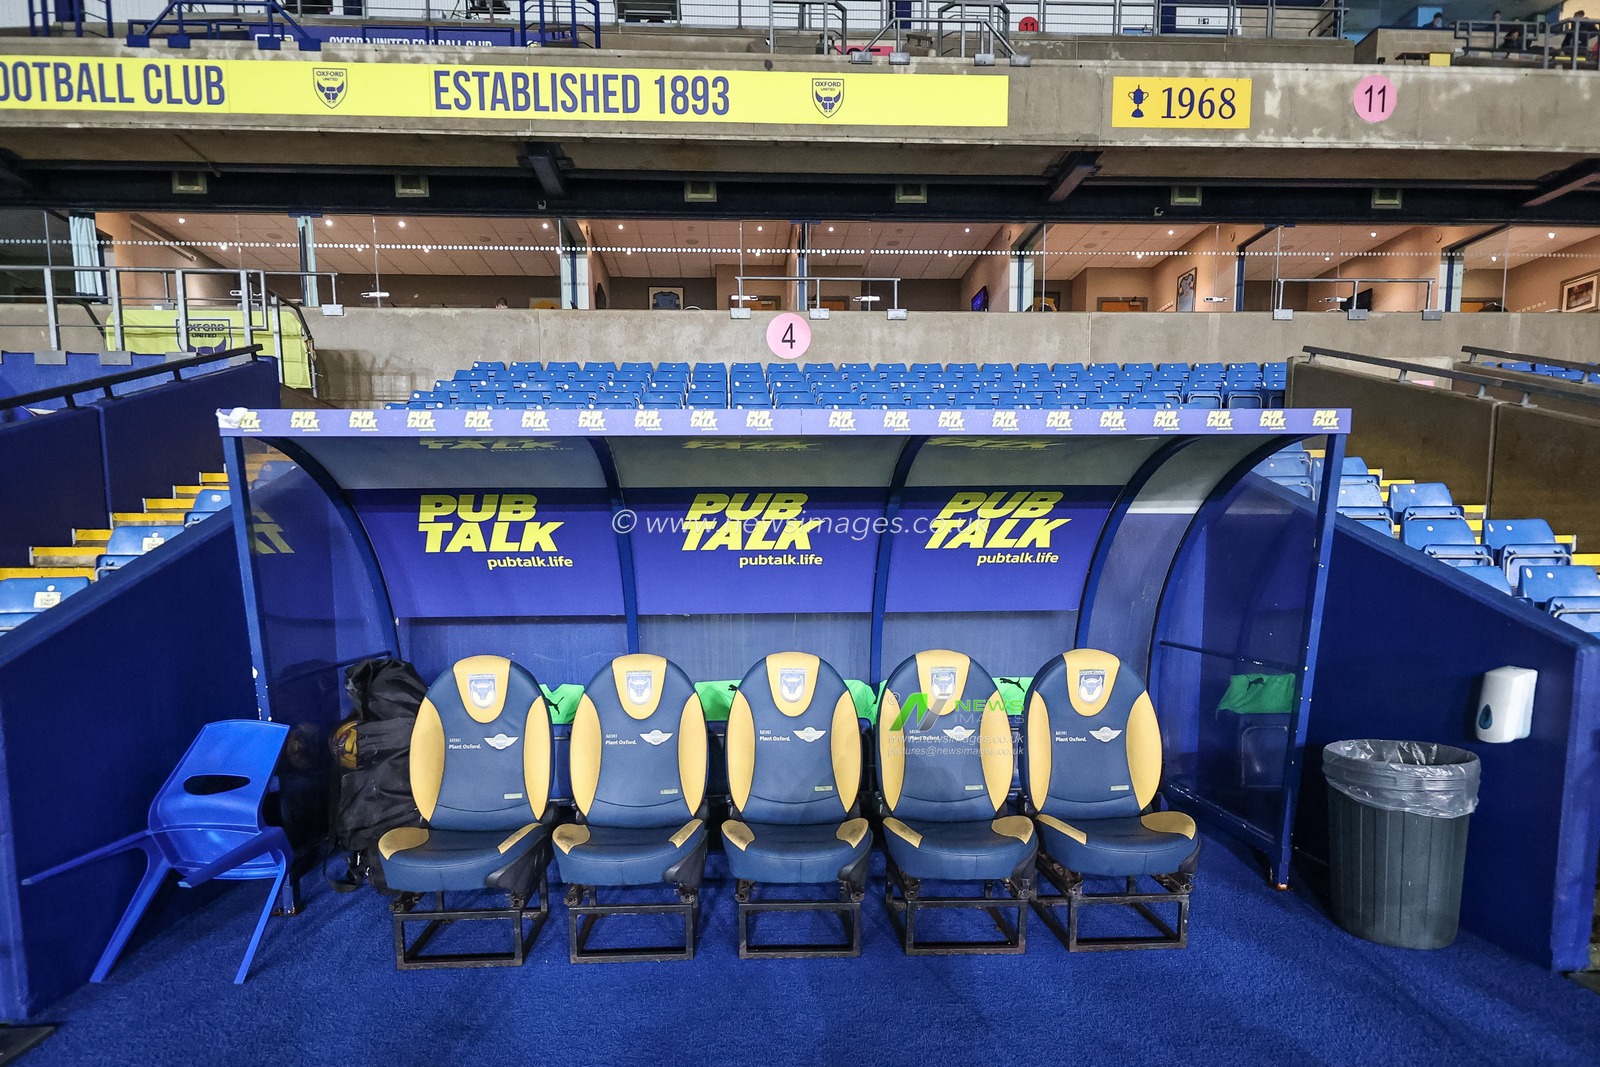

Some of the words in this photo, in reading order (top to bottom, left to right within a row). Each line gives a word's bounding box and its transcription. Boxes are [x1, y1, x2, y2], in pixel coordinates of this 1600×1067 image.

[143, 63, 225, 105] CLUB
[434, 70, 640, 113] ESTABLISHED
[654, 75, 730, 115] 1893
[1161, 86, 1236, 120] 1968
[1364, 84, 1387, 113] 11
[188, 323, 225, 332] XFORD
[781, 322, 796, 350] 4
[292, 412, 315, 420] PUB
[351, 411, 374, 419] PUB
[409, 411, 431, 419] PUB
[466, 411, 489, 419] PUB
[523, 411, 546, 419] PUB
[580, 411, 602, 419] PUB
[636, 411, 658, 419] PUB
[692, 411, 714, 419] PUB
[748, 411, 770, 419] PUB
[831, 411, 852, 419] PUB
[886, 411, 907, 419] PUB
[940, 412, 961, 420] PUB
[994, 412, 1016, 420] PUB
[1048, 411, 1069, 419] PUB
[1102, 411, 1123, 419] PUB
[1156, 411, 1177, 419] PUB
[1209, 411, 1230, 419] PUB
[1262, 411, 1283, 419] PUB
[1315, 411, 1336, 419] PUB
[240, 419, 261, 428] ALK
[291, 419, 318, 427] TALK
[349, 418, 376, 427] TALK
[407, 418, 434, 427] TALK
[465, 418, 491, 427] TALK
[522, 418, 548, 427] TALK
[578, 418, 604, 427] TALK
[635, 418, 660, 427] TALK
[691, 418, 716, 427] TALK
[746, 418, 771, 427] TALK
[829, 418, 854, 427] TALK
[884, 418, 909, 427] TALK
[938, 419, 963, 427] TALK
[992, 419, 1017, 427] TALK
[1046, 418, 1071, 427] TALK
[1100, 418, 1124, 427] TALK
[1154, 418, 1178, 427] TALK
[1207, 418, 1232, 426] TALK
[1260, 418, 1284, 426] TALK
[1313, 418, 1337, 426] TALK
[418, 494, 538, 522] PUB
[685, 492, 808, 520] PUB
[936, 491, 1064, 519] PUB
[418, 521, 565, 553] TALK
[681, 520, 826, 551] TALK
[924, 518, 1072, 550] TALK
[487, 556, 574, 570] pubtalk.life
[739, 554, 824, 568] pubtalk.life
[976, 552, 1059, 566] pubtalk.life
